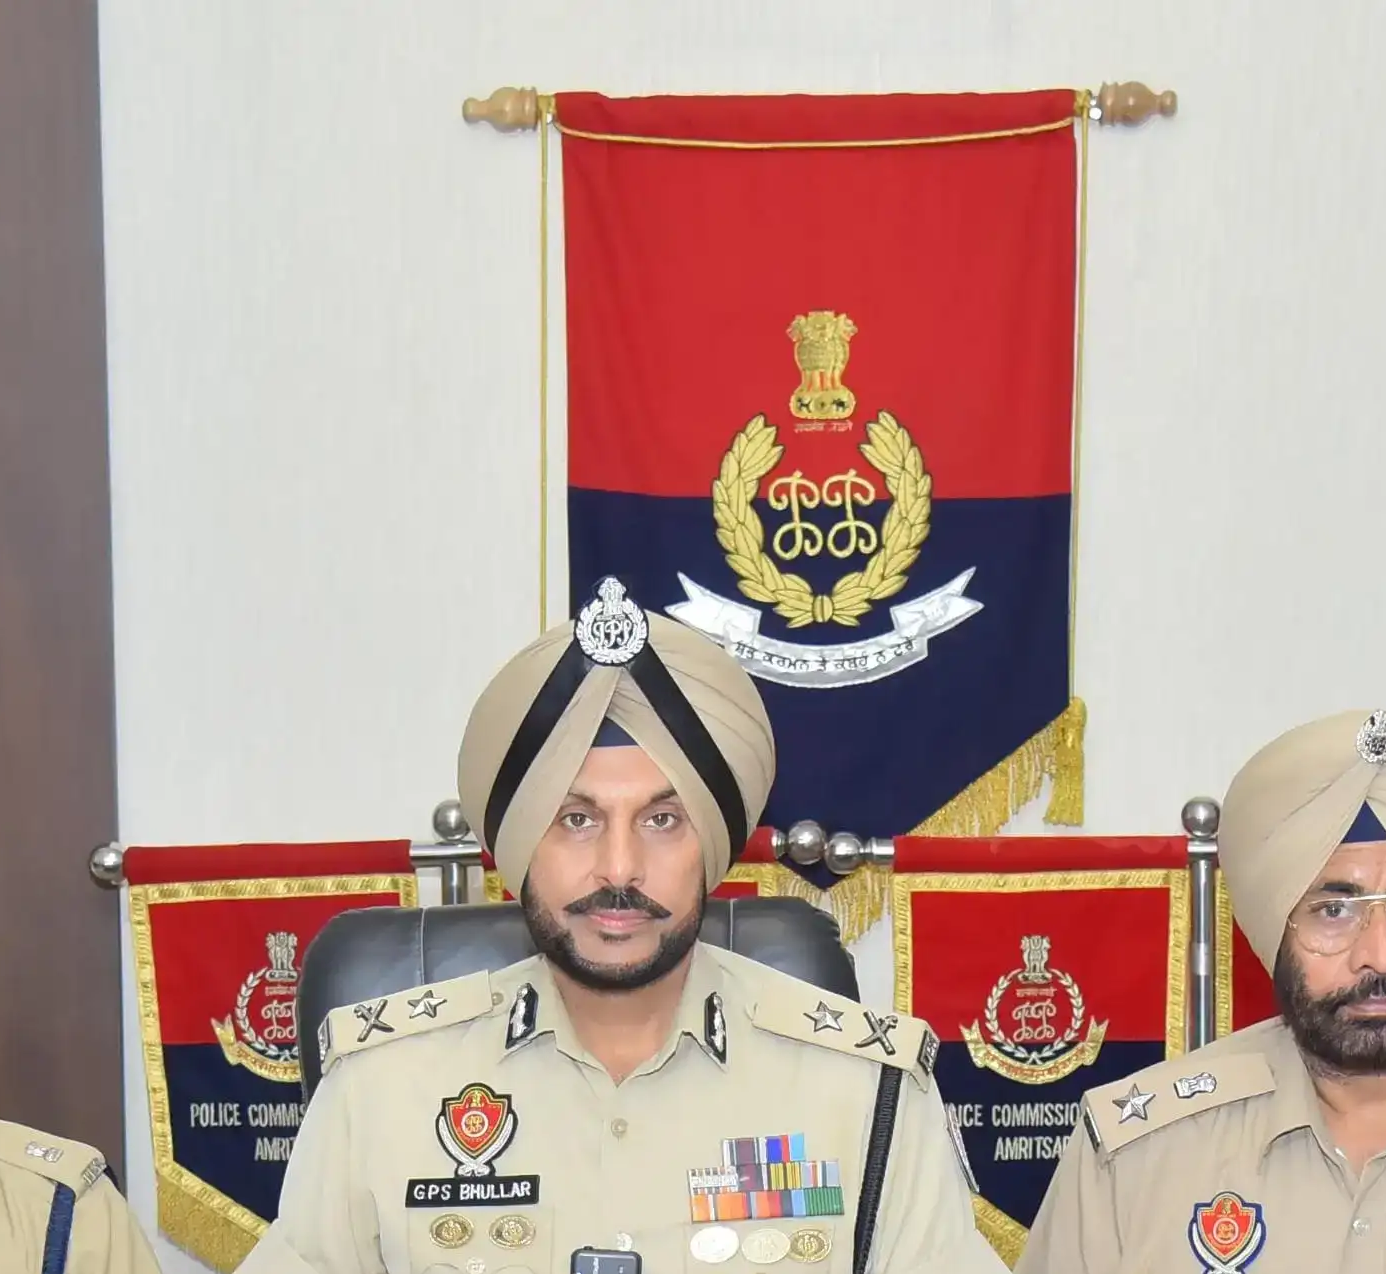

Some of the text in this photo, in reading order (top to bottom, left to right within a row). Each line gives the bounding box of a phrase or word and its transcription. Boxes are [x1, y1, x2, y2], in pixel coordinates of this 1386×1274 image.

[190, 1103, 307, 1128] POLICE COMMIS
[991, 1102, 1080, 1127] COMMISSIO
[254, 1137, 295, 1161] AMRI
[413, 1181, 531, 1200] GPS BHULLAR
